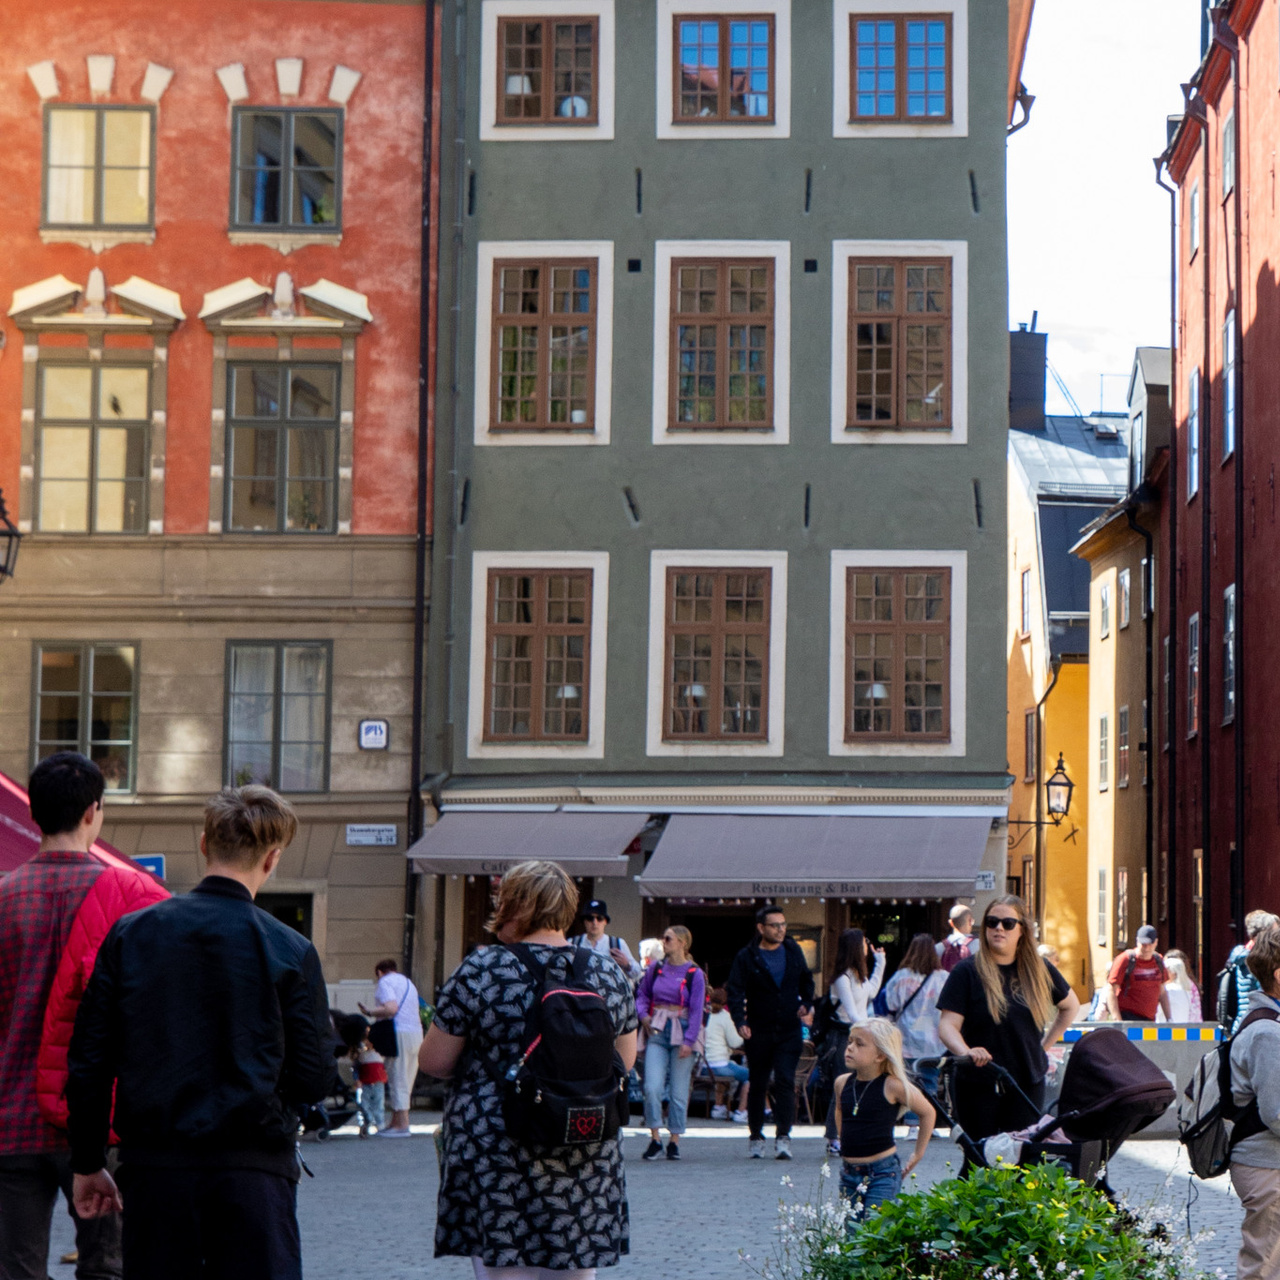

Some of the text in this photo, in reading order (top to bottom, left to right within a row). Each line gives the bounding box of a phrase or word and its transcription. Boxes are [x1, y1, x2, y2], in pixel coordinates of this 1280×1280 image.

[752, 883, 863, 894] Restaurang & Bar
